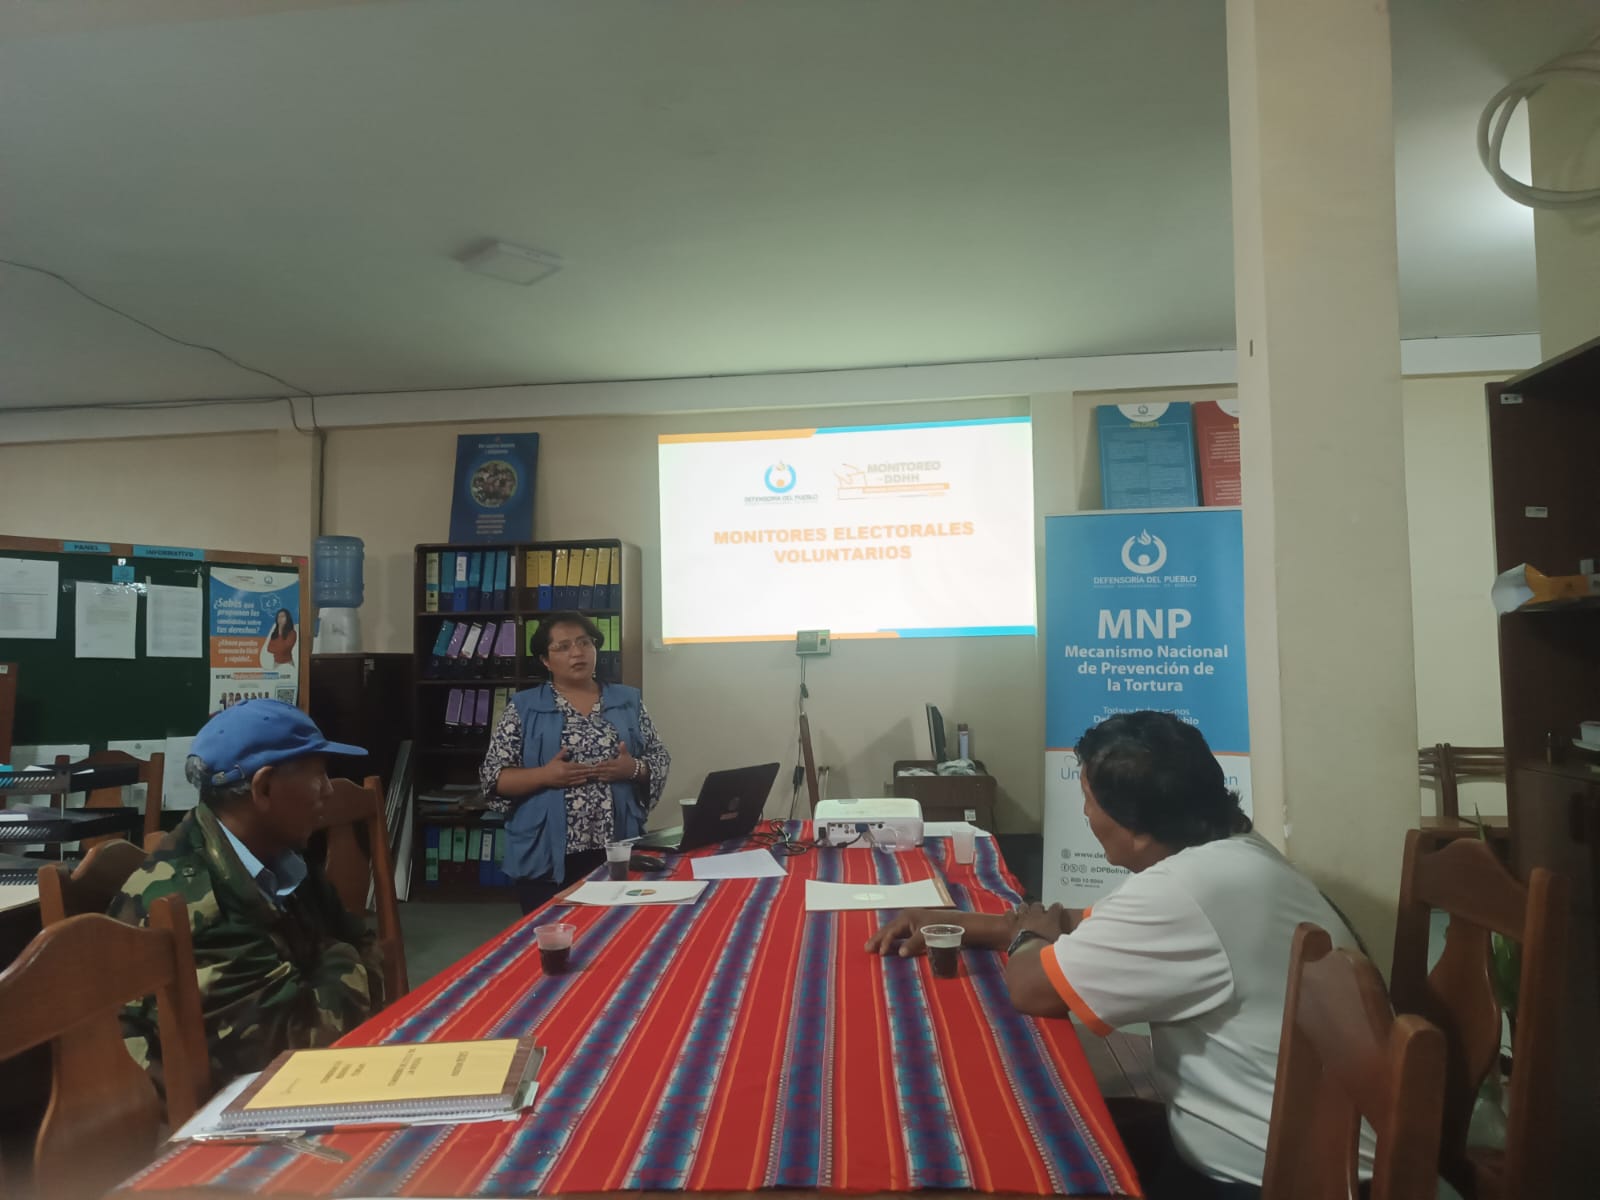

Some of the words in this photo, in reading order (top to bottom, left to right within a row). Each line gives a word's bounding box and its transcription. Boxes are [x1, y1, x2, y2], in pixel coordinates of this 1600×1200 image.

[867, 461, 941, 473] MONITOREO
[714, 527, 827, 545] MONITORES
[833, 521, 974, 541] ELECTORALES
[145, 550, 194, 558] INFORMATIVO
[774, 545, 912, 564] VOLUNTARIOS
[1093, 574, 1145, 585] DEFENSORÍA
[1146, 575, 1162, 584] DEL
[1163, 574, 1197, 584] PUEBLO
[1097, 608, 1192, 639] MNP
[1064, 645, 1153, 658] Mecanismo
[1157, 644, 1228, 658] Nacional
[1078, 662, 1097, 675] de
[1101, 662, 1189, 675] Prevención
[1194, 662, 1214, 675] de
[1107, 678, 1121, 691] la
[1124, 678, 1183, 692] Tortura
